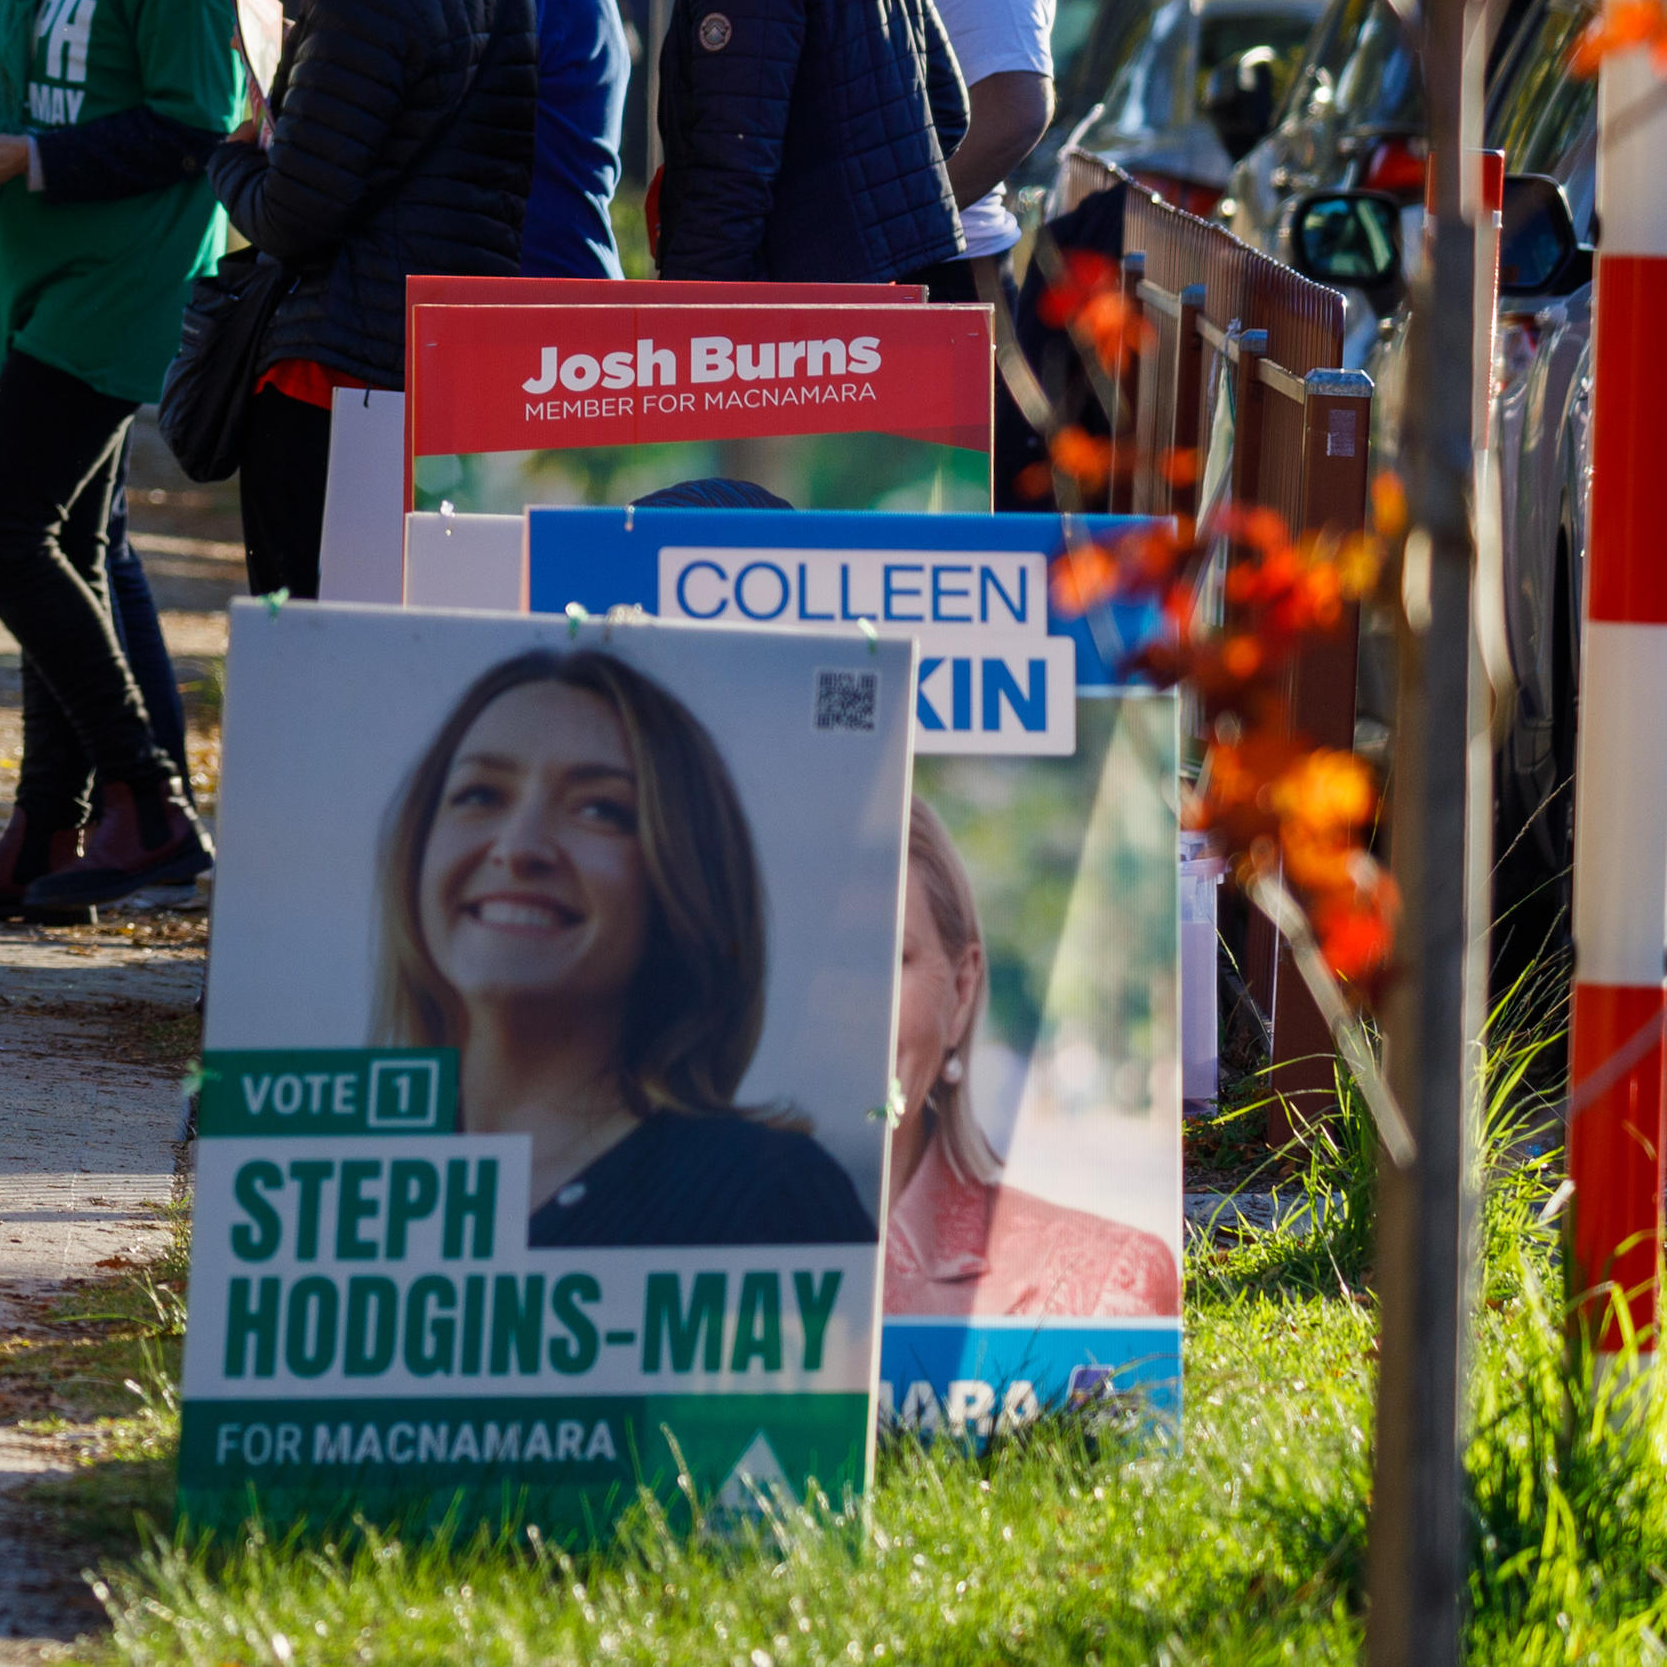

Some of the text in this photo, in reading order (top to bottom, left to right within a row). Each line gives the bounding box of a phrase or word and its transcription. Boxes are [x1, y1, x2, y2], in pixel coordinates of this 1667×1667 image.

[522, 335, 882, 395] Josh Burns
[525, 382, 877, 421] MEMBER FOR MACNAMARA
[676, 559, 1028, 624] COLLEEN
[241, 1073, 411, 1115] VOTE 1
[230, 1158, 499, 1262] STEPH
[222, 1270, 844, 1381] HODGINS-MAY
[216, 1419, 617, 1466] FOR MACNAMARA
